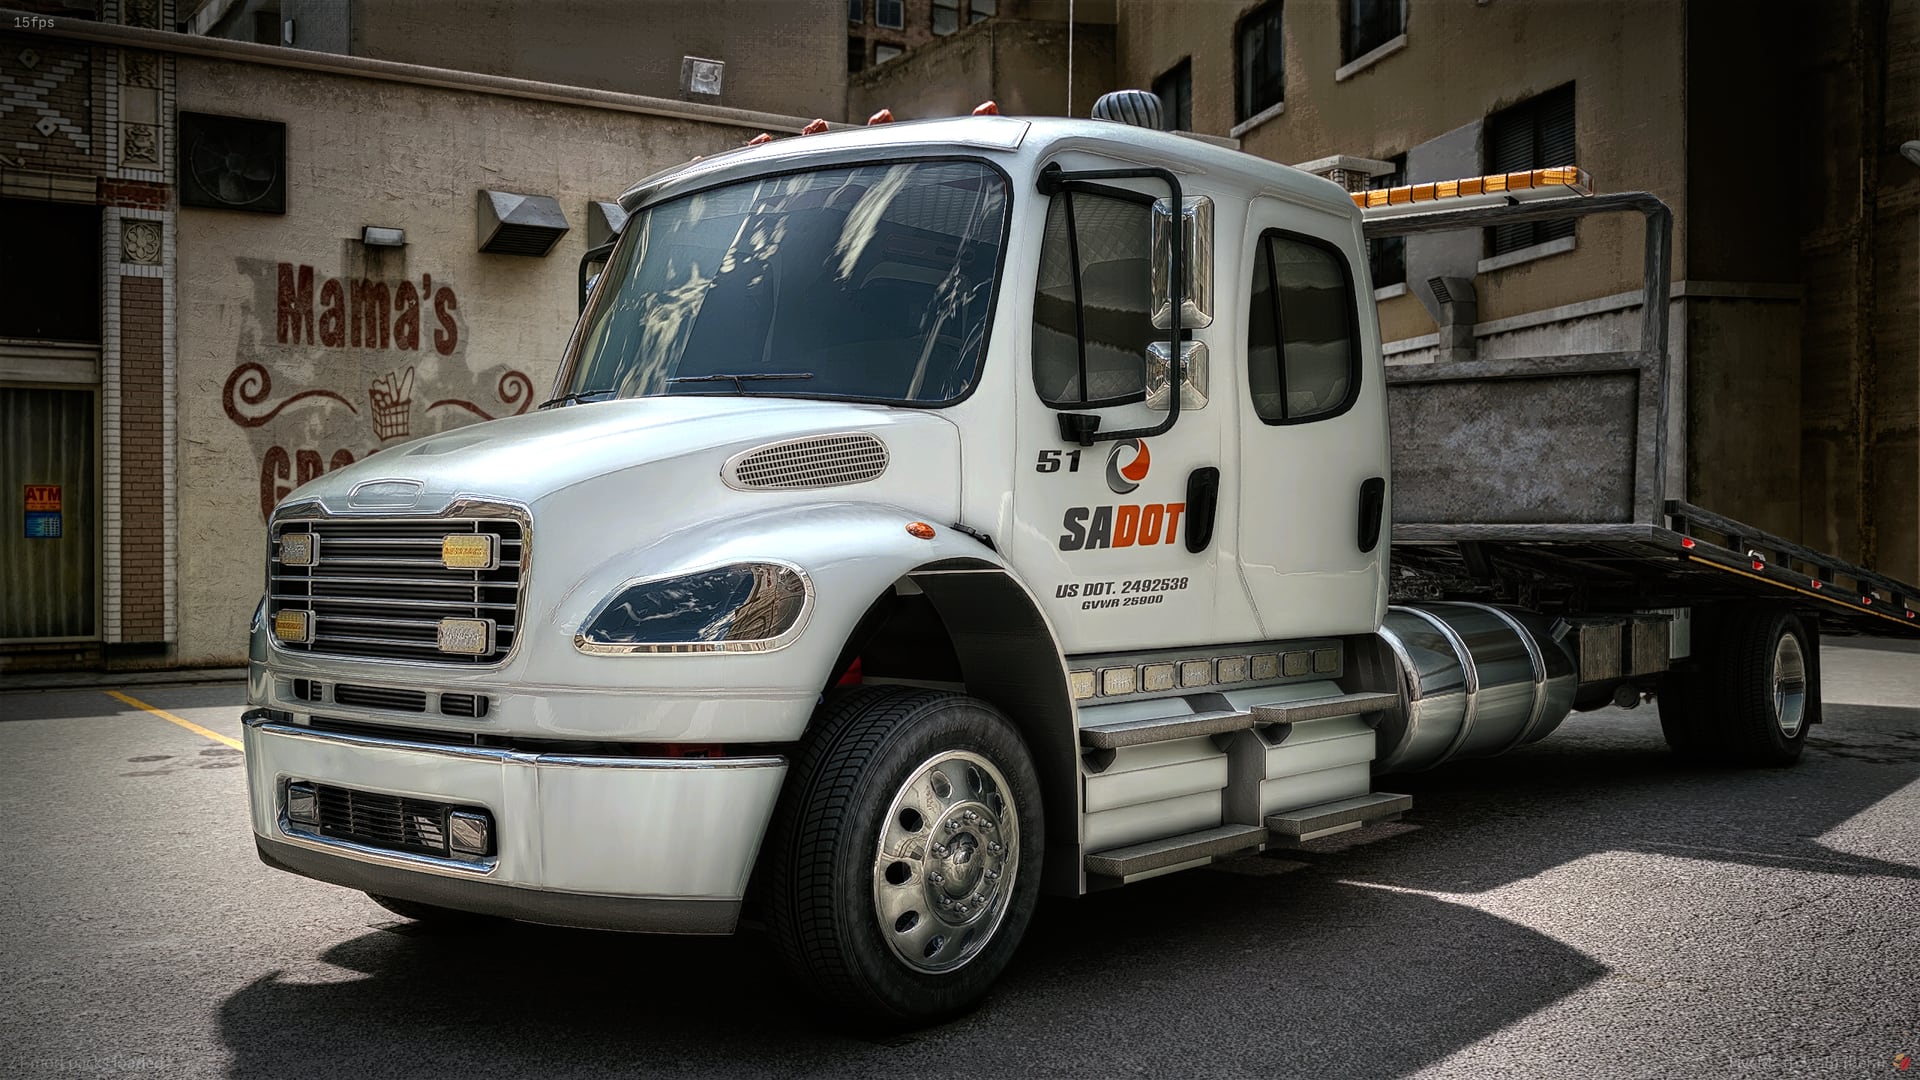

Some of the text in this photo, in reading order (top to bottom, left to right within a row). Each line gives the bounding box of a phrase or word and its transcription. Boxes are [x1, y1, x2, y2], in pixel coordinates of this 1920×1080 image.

[276, 262, 458, 356] Mama's
[1036, 449, 1082, 473] 51
[25, 487, 61, 501] ATM
[1058, 502, 1186, 551] SADOT
[1055, 577, 1189, 598] US DOT. 2492538
[1081, 594, 1163, 610] GVWR 25900
